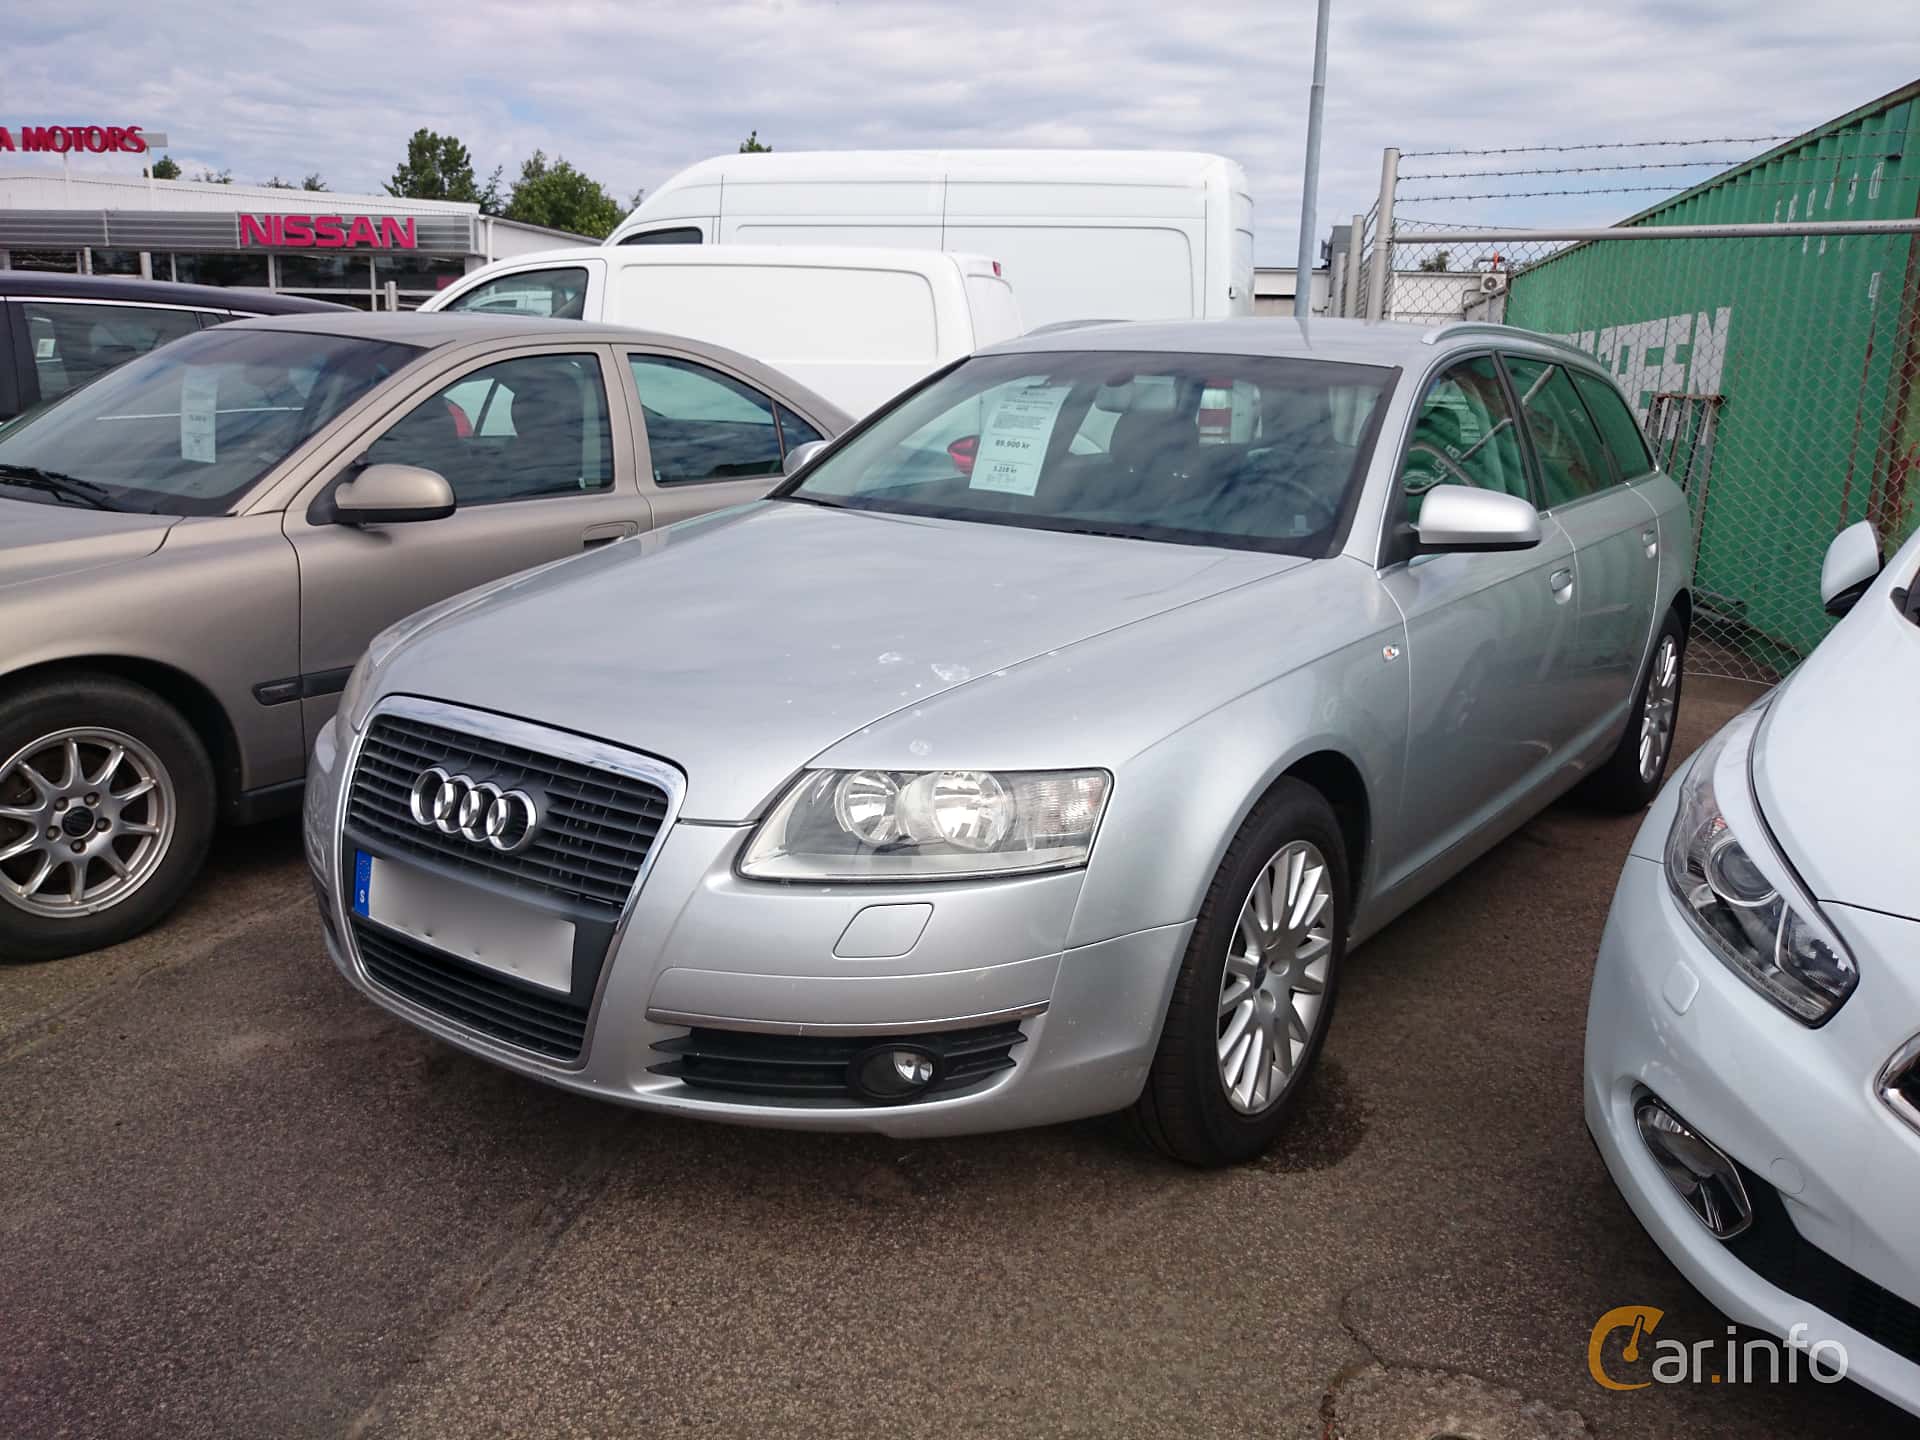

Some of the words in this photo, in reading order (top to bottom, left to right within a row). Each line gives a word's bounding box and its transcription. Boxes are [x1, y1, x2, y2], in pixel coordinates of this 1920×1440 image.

[21, 125, 146, 153] MOTORS
[239, 214, 415, 249] NISSAN
[359, 889, 366, 904] S
